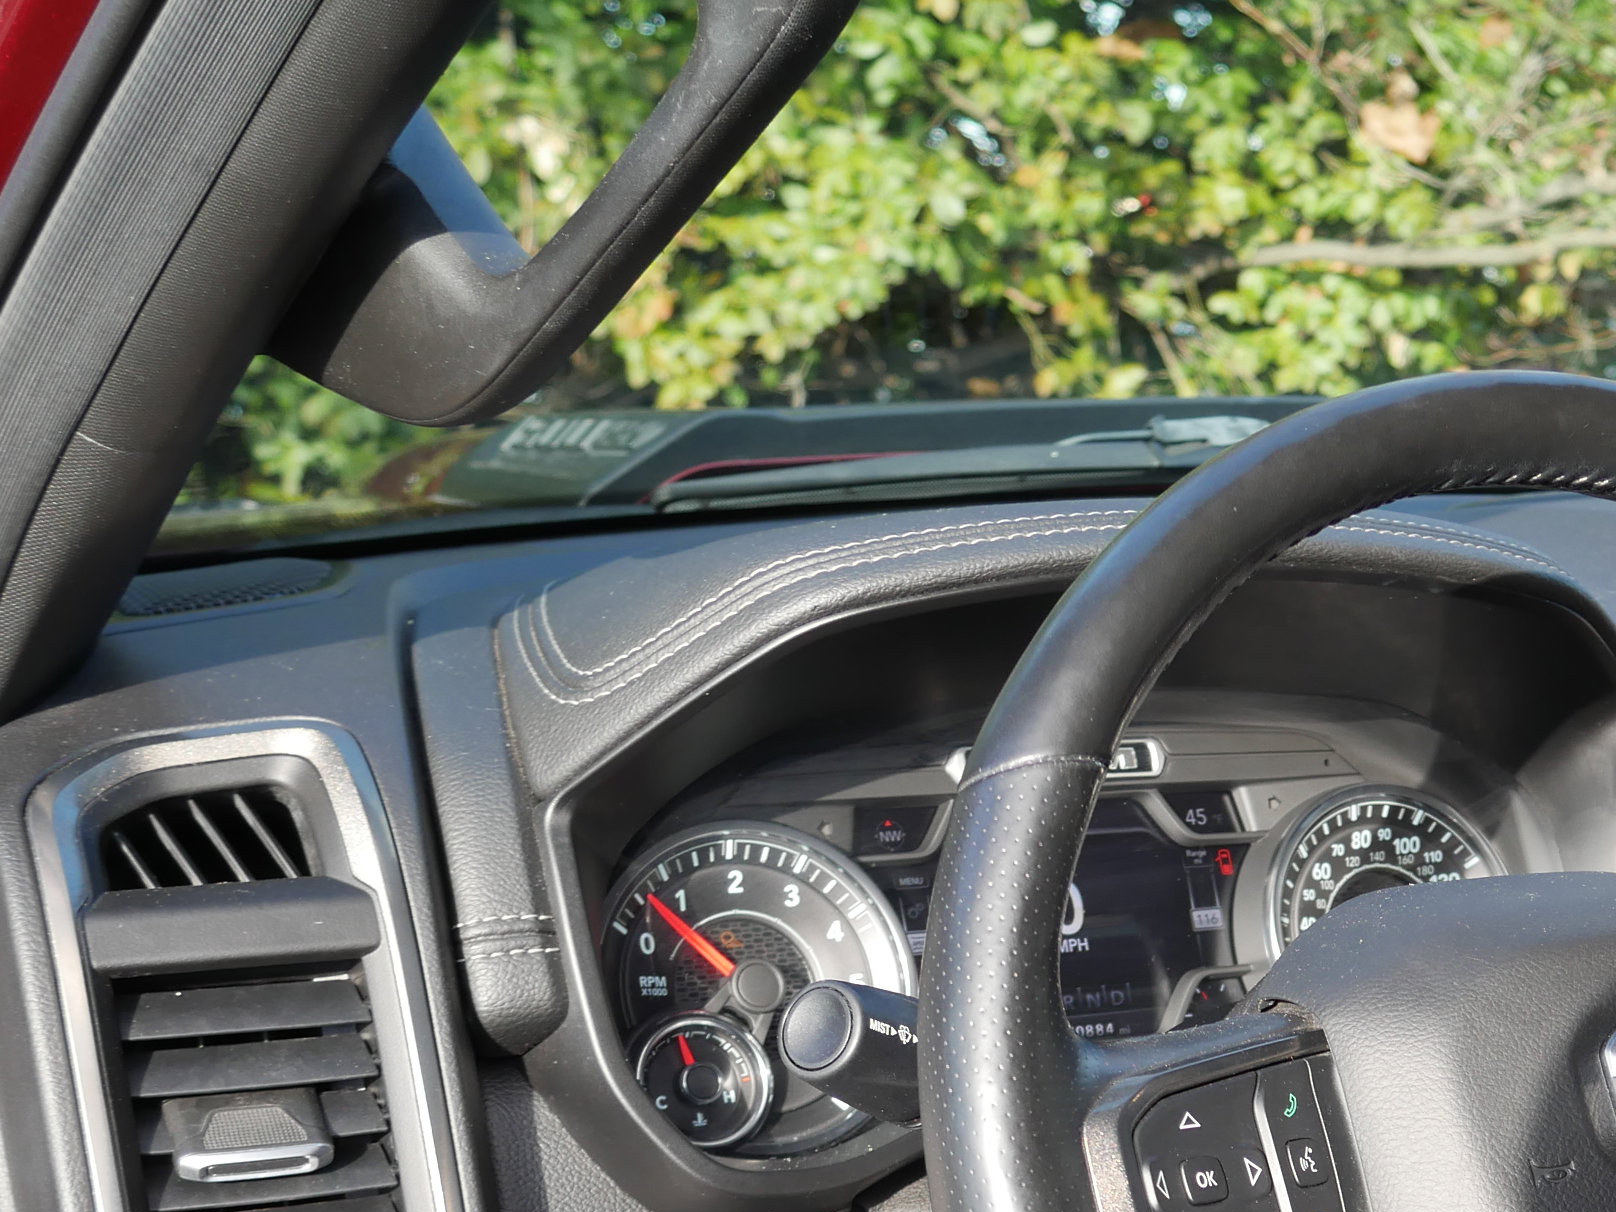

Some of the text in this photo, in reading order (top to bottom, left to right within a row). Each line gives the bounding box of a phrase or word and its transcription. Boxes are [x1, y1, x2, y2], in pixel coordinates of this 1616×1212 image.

[1185, 808, 1207, 825] 45
[879, 829, 902, 843] NW
[1351, 829, 1372, 849] 80
[1377, 828, 1392, 841] 90
[1331, 844, 1345, 857] 70
[1393, 836, 1421, 855] 100
[1345, 856, 1361, 868] 120
[1370, 851, 1386, 862] 140
[1398, 854, 1415, 865] 160
[1423, 850, 1443, 863] 110
[1312, 862, 1331, 881] 60
[1417, 865, 1435, 876] 180
[727, 870, 744, 894] 2
[1320, 880, 1335, 890] 100
[675, 889, 687, 912] 1
[784, 885, 800, 908] 3
[1303, 889, 1316, 901] 50
[1197, 913, 1219, 926] 116
[826, 920, 845, 943] 4
[639, 934, 656, 954] 0
[1060, 937, 1090, 953] MPH
[639, 976, 667, 988] RPM
[1086, 993, 1100, 1008] N
[1110, 990, 1124, 1006] D
[870, 1018, 892, 1036] MIST
[655, 1095, 668, 1110] C
[723, 1090, 736, 1104] H
[1196, 1169, 1218, 1189] OK
